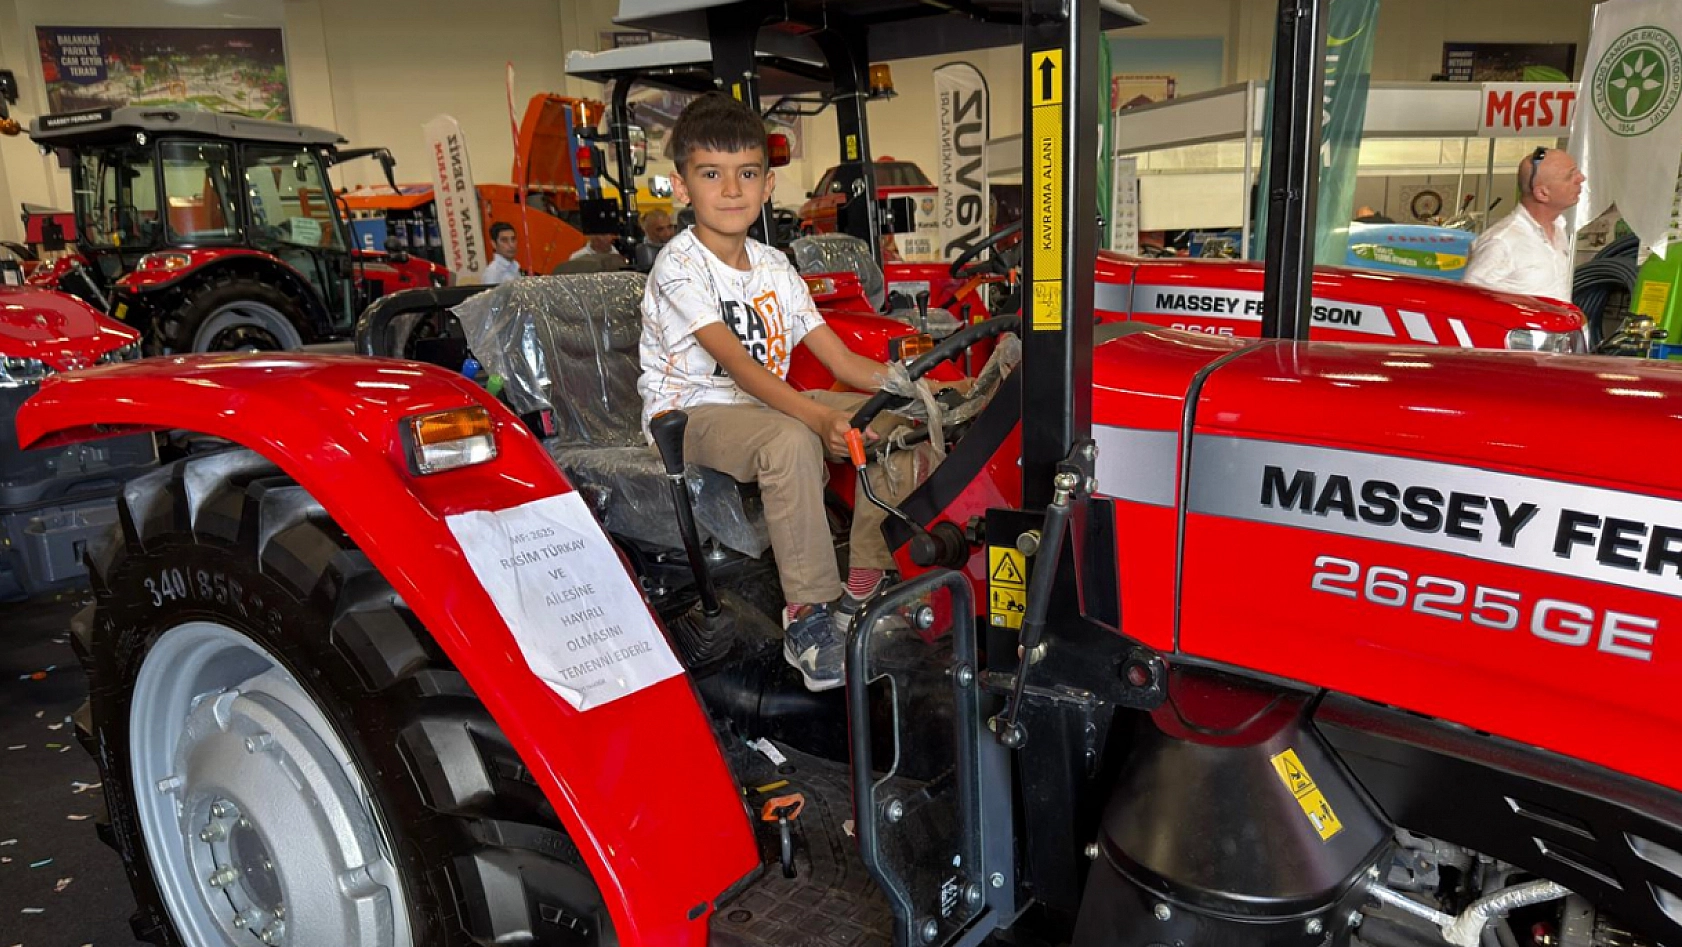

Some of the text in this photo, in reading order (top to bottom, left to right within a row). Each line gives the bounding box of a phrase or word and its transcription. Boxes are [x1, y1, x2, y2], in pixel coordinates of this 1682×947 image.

[1486, 91, 1576, 132] MAST
[1042, 137, 1053, 250] KAVRAMA ALANI
[1155, 293, 1362, 327] MASSEY FESON
[1260, 464, 1540, 548] MASSEY
[532, 527, 555, 541] 2625
[500, 538, 586, 570] RASİM TÜRKAY
[548, 567, 566, 581] VE
[545, 583, 596, 607] AİLESİNE
[1311, 554, 1659, 662] 2625GE
[560, 606, 605, 628] HAYIRLI
[566, 625, 624, 652] OLMASINI
[558, 641, 653, 680] TEMENNİ EDERİZ
